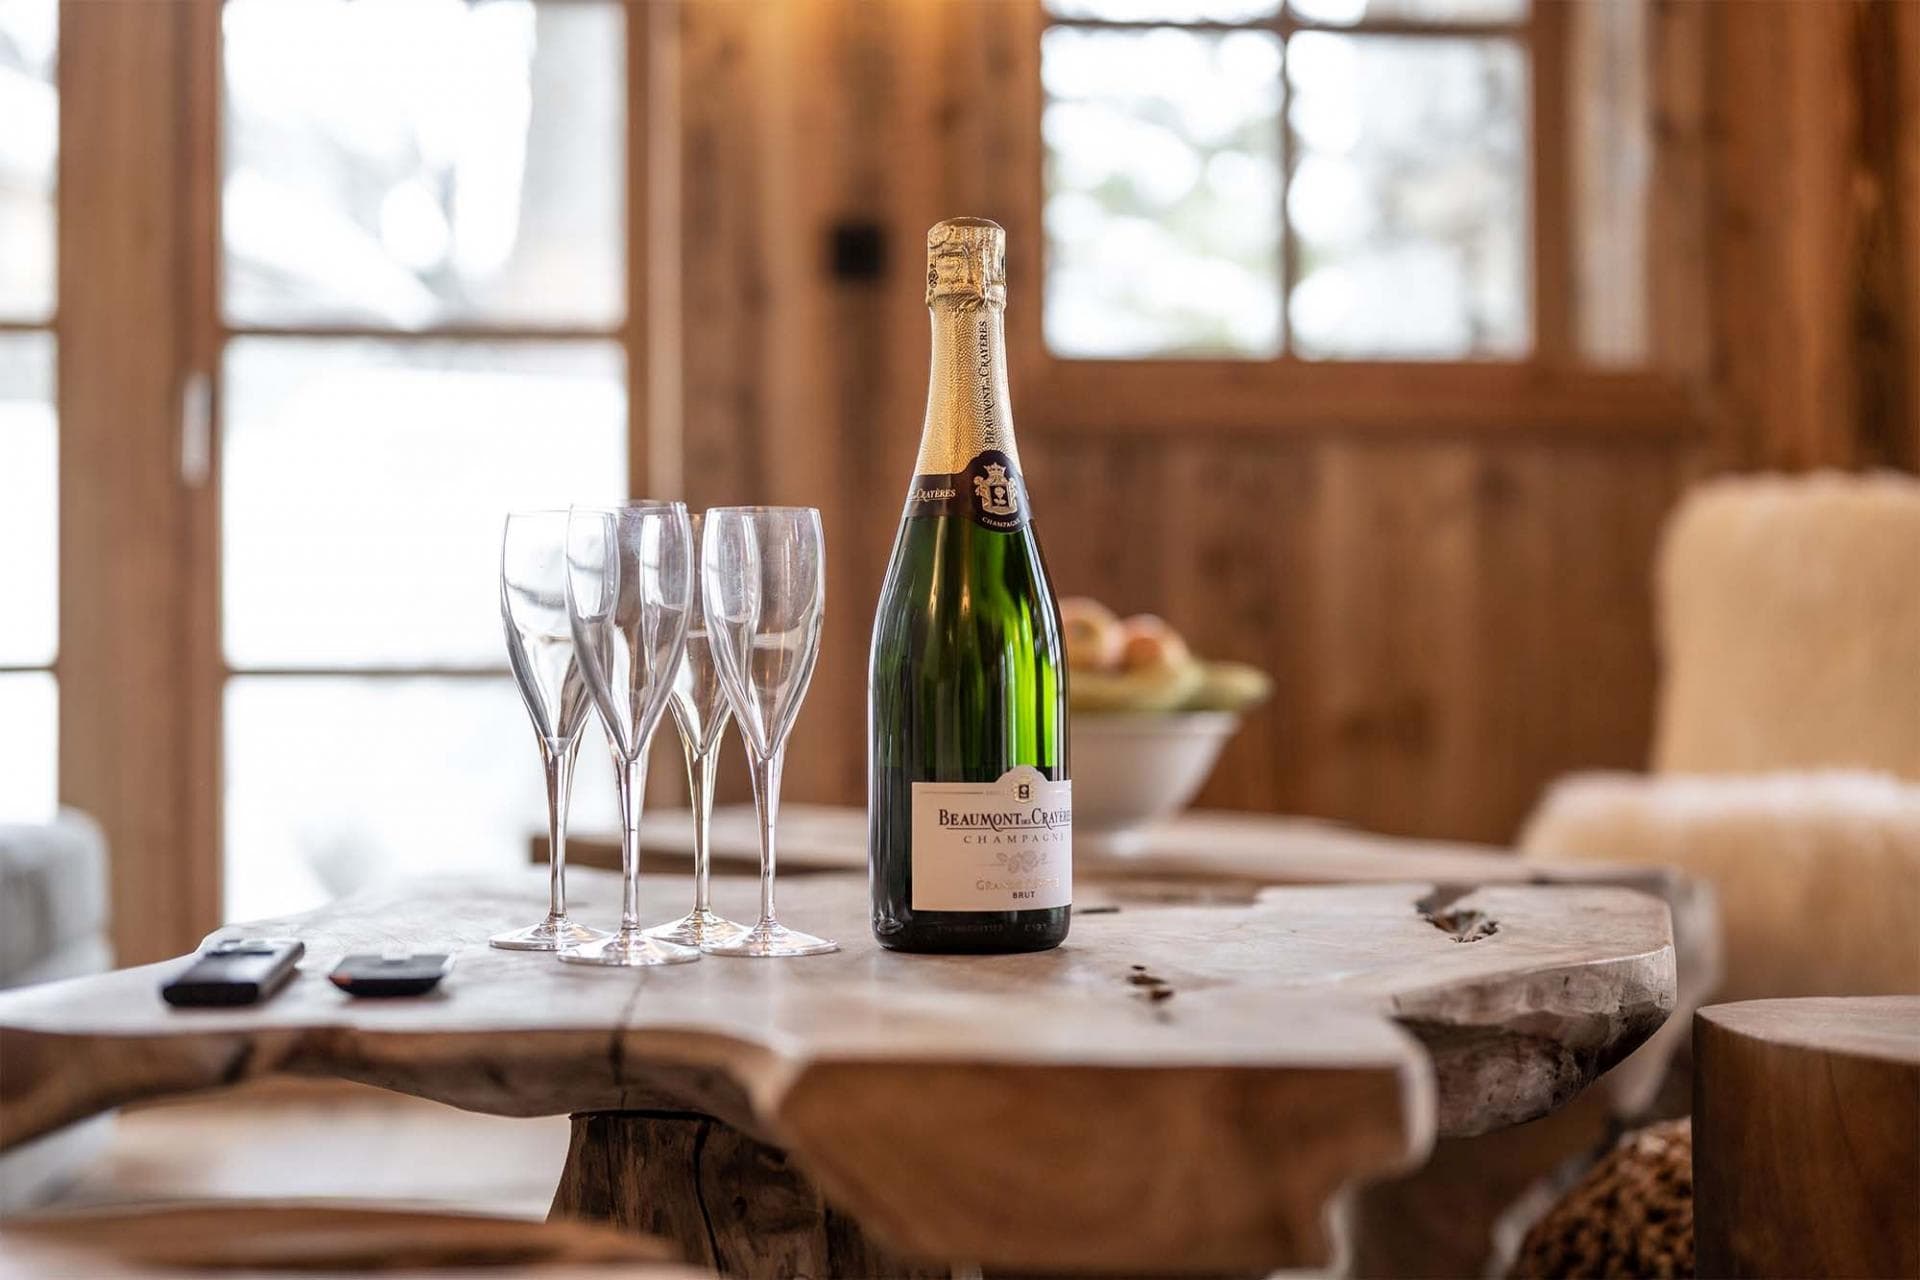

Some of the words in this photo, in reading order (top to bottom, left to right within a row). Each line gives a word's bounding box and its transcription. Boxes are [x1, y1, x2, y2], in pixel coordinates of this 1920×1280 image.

[982, 516, 1021, 528] CHAMPAGN
[939, 808, 1022, 832] BEAUMONT
[1012, 891, 1035, 899] BRUT
